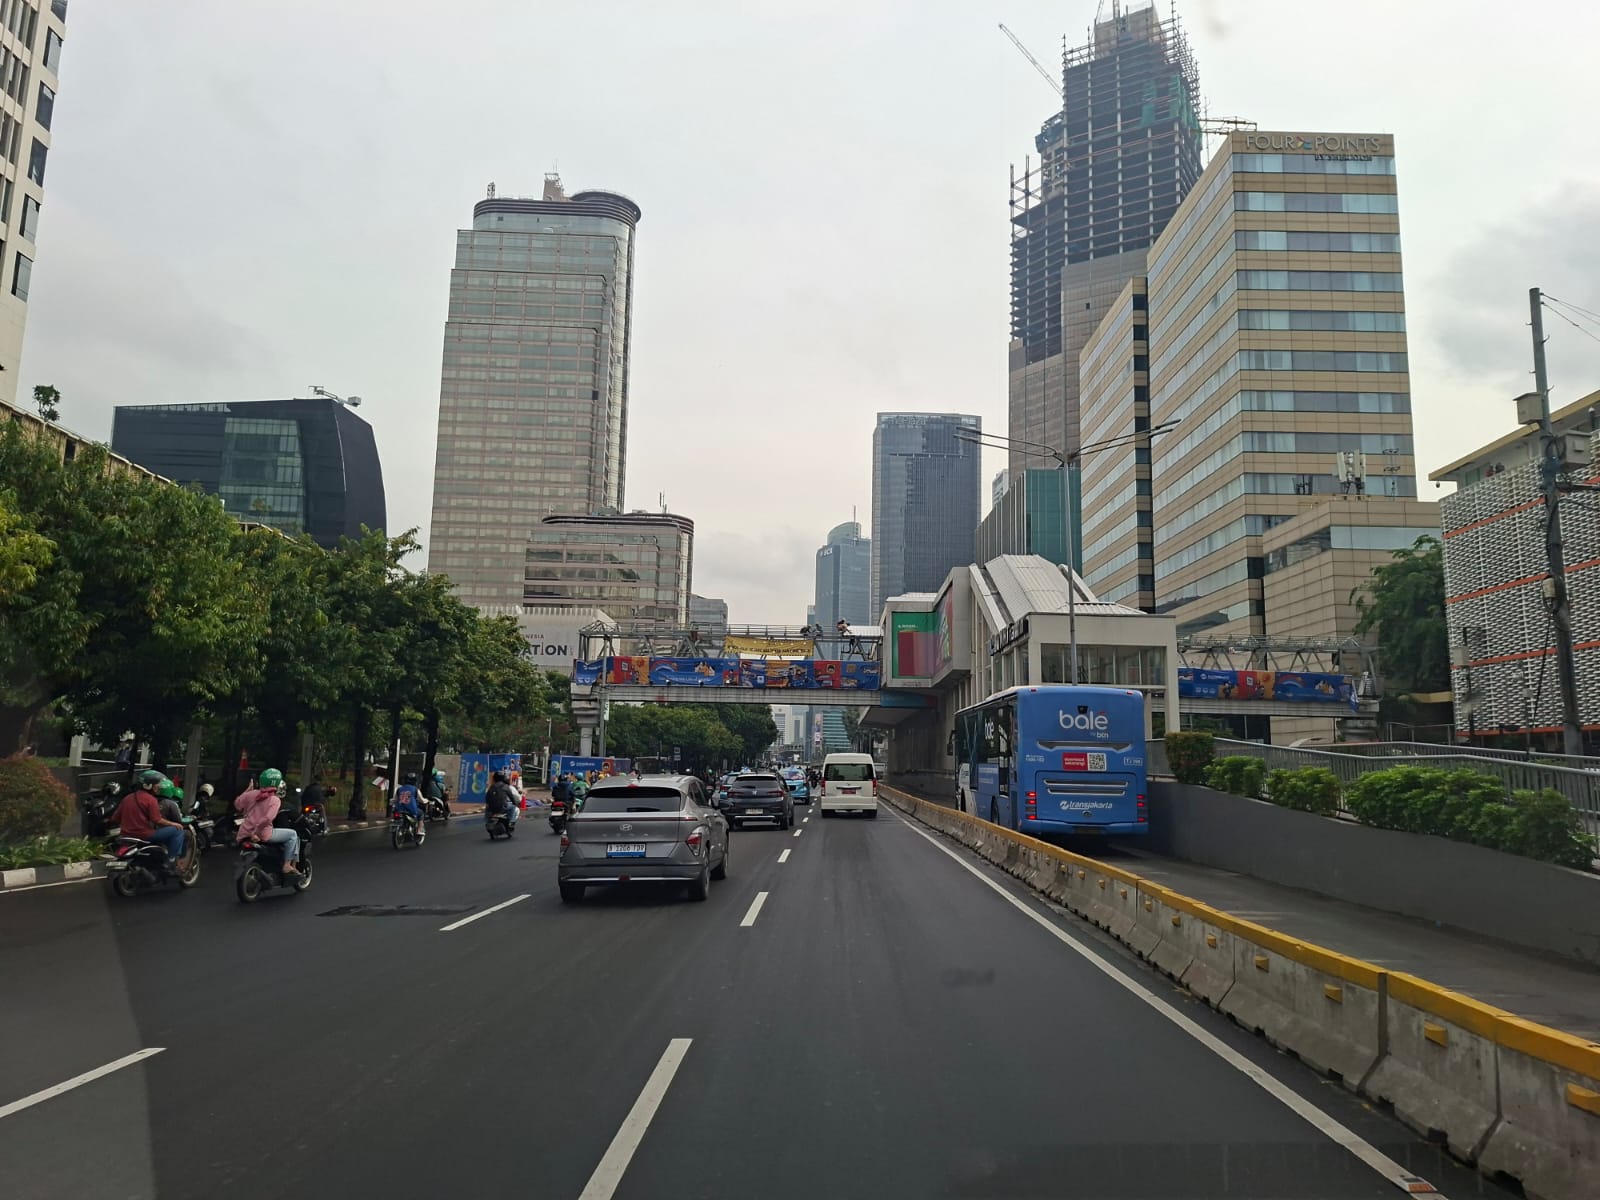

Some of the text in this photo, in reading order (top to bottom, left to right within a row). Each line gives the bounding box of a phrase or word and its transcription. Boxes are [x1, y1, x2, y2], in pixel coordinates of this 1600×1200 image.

[1246, 134, 1381, 152] FOUR POINTS
[521, 641, 567, 656] ATION
[1069, 800, 1113, 810] transjakarta
